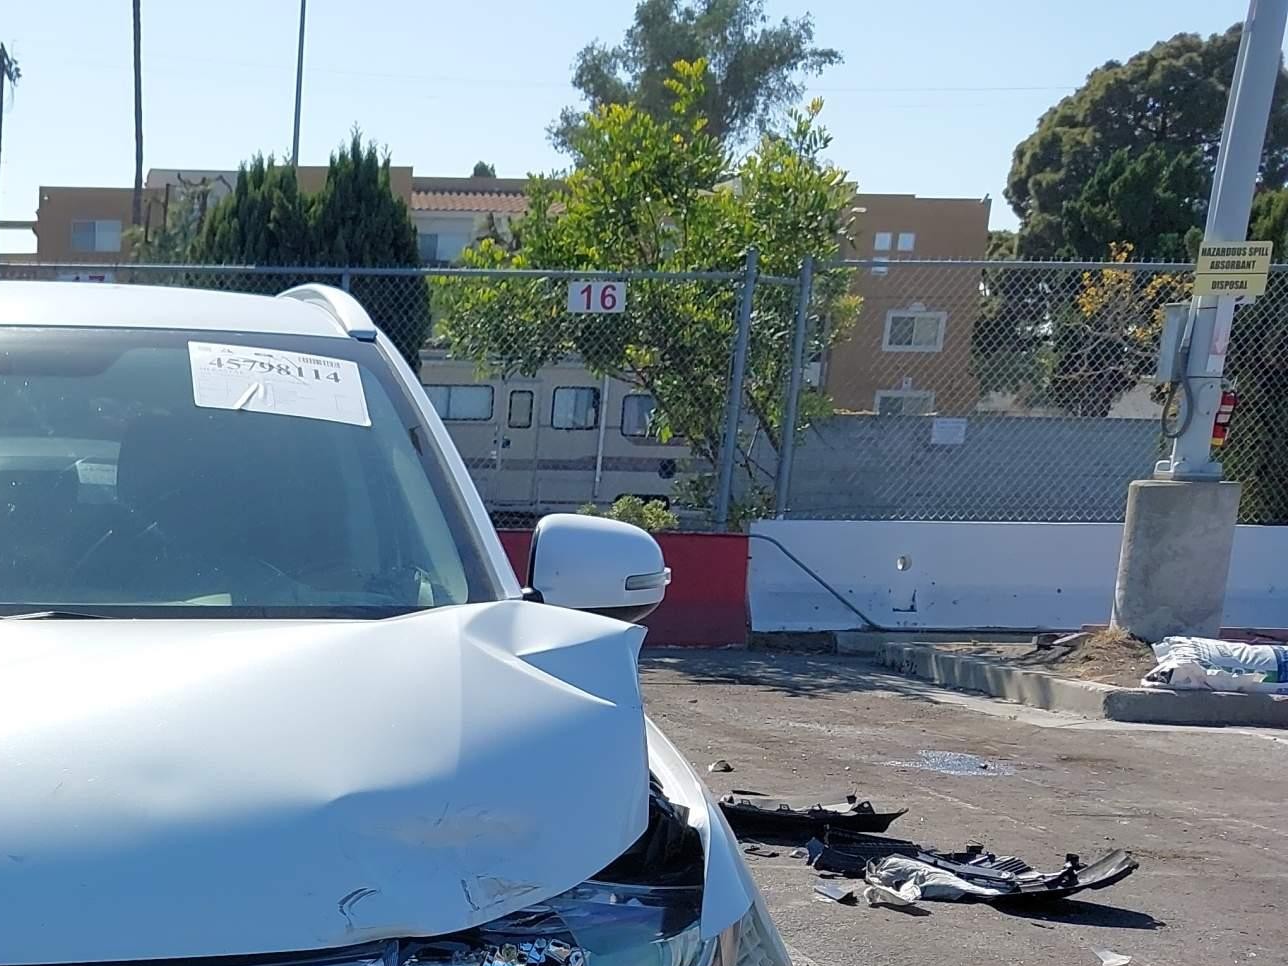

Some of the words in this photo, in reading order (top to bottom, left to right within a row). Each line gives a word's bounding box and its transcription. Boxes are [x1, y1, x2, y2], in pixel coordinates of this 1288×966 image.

[1201, 247, 1247, 257] HAZARDOUS
[1248, 247, 1269, 257] SPILL
[1210, 260, 1256, 270] ABSORBANT
[1211, 280, 1248, 290] DISPOSAL
[580, 284, 617, 310] 16
[208, 357, 342, 383] 45798114
